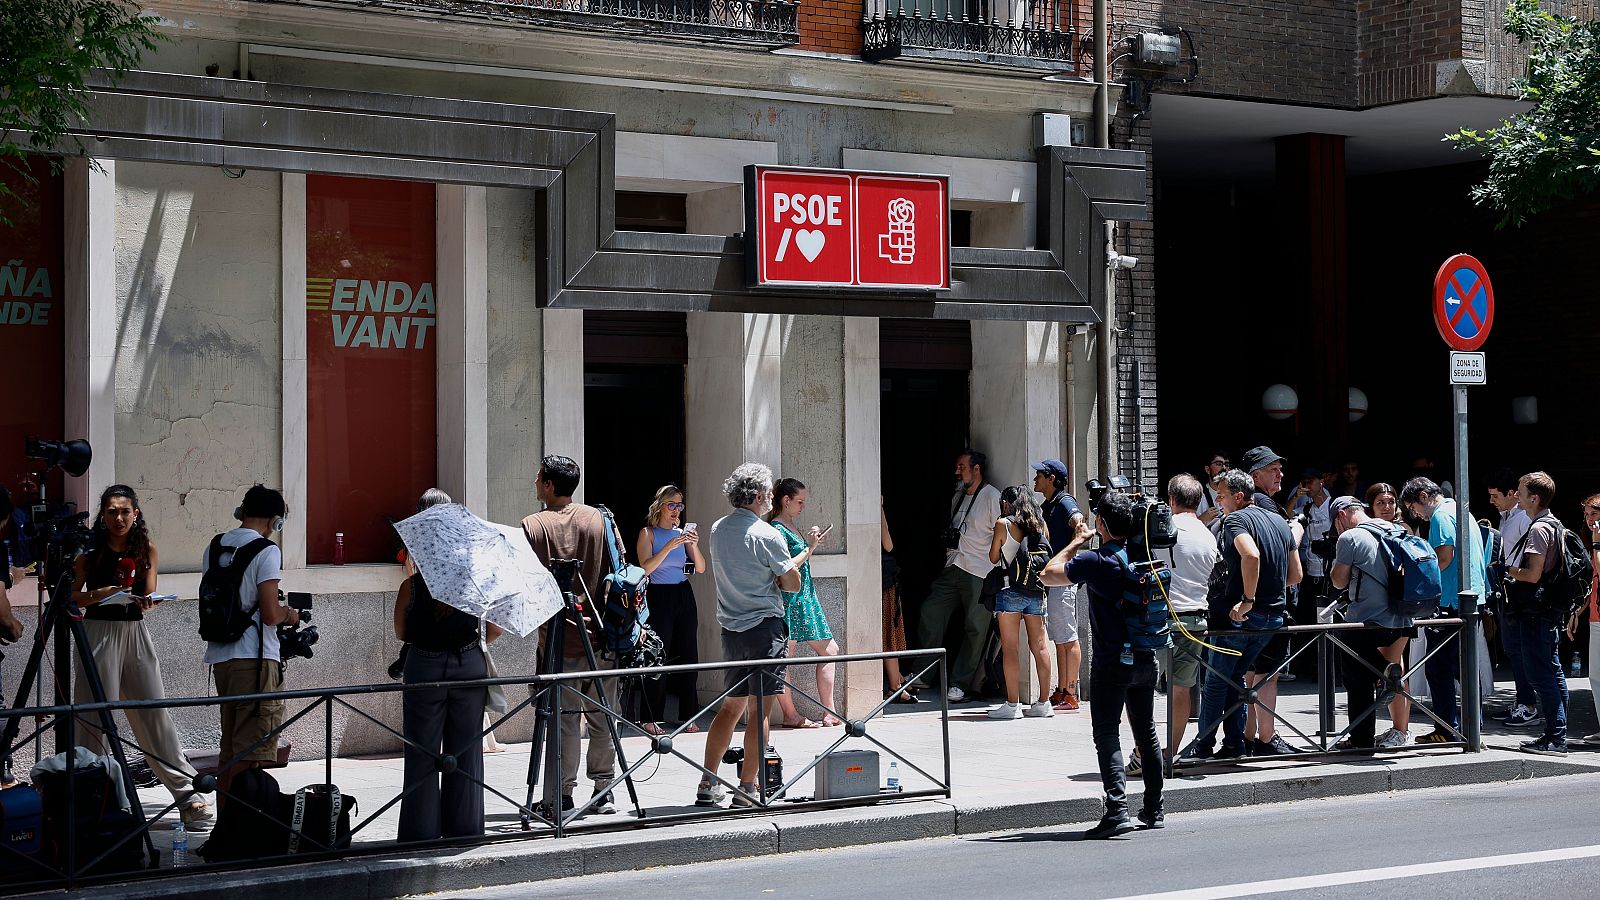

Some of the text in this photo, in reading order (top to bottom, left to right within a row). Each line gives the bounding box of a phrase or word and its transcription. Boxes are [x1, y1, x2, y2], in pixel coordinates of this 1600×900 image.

[773, 192, 842, 226] PSOE
[331, 278, 436, 314] ENDA
[331, 314, 436, 349] VANT
[11, 831, 33, 841] LiveU
